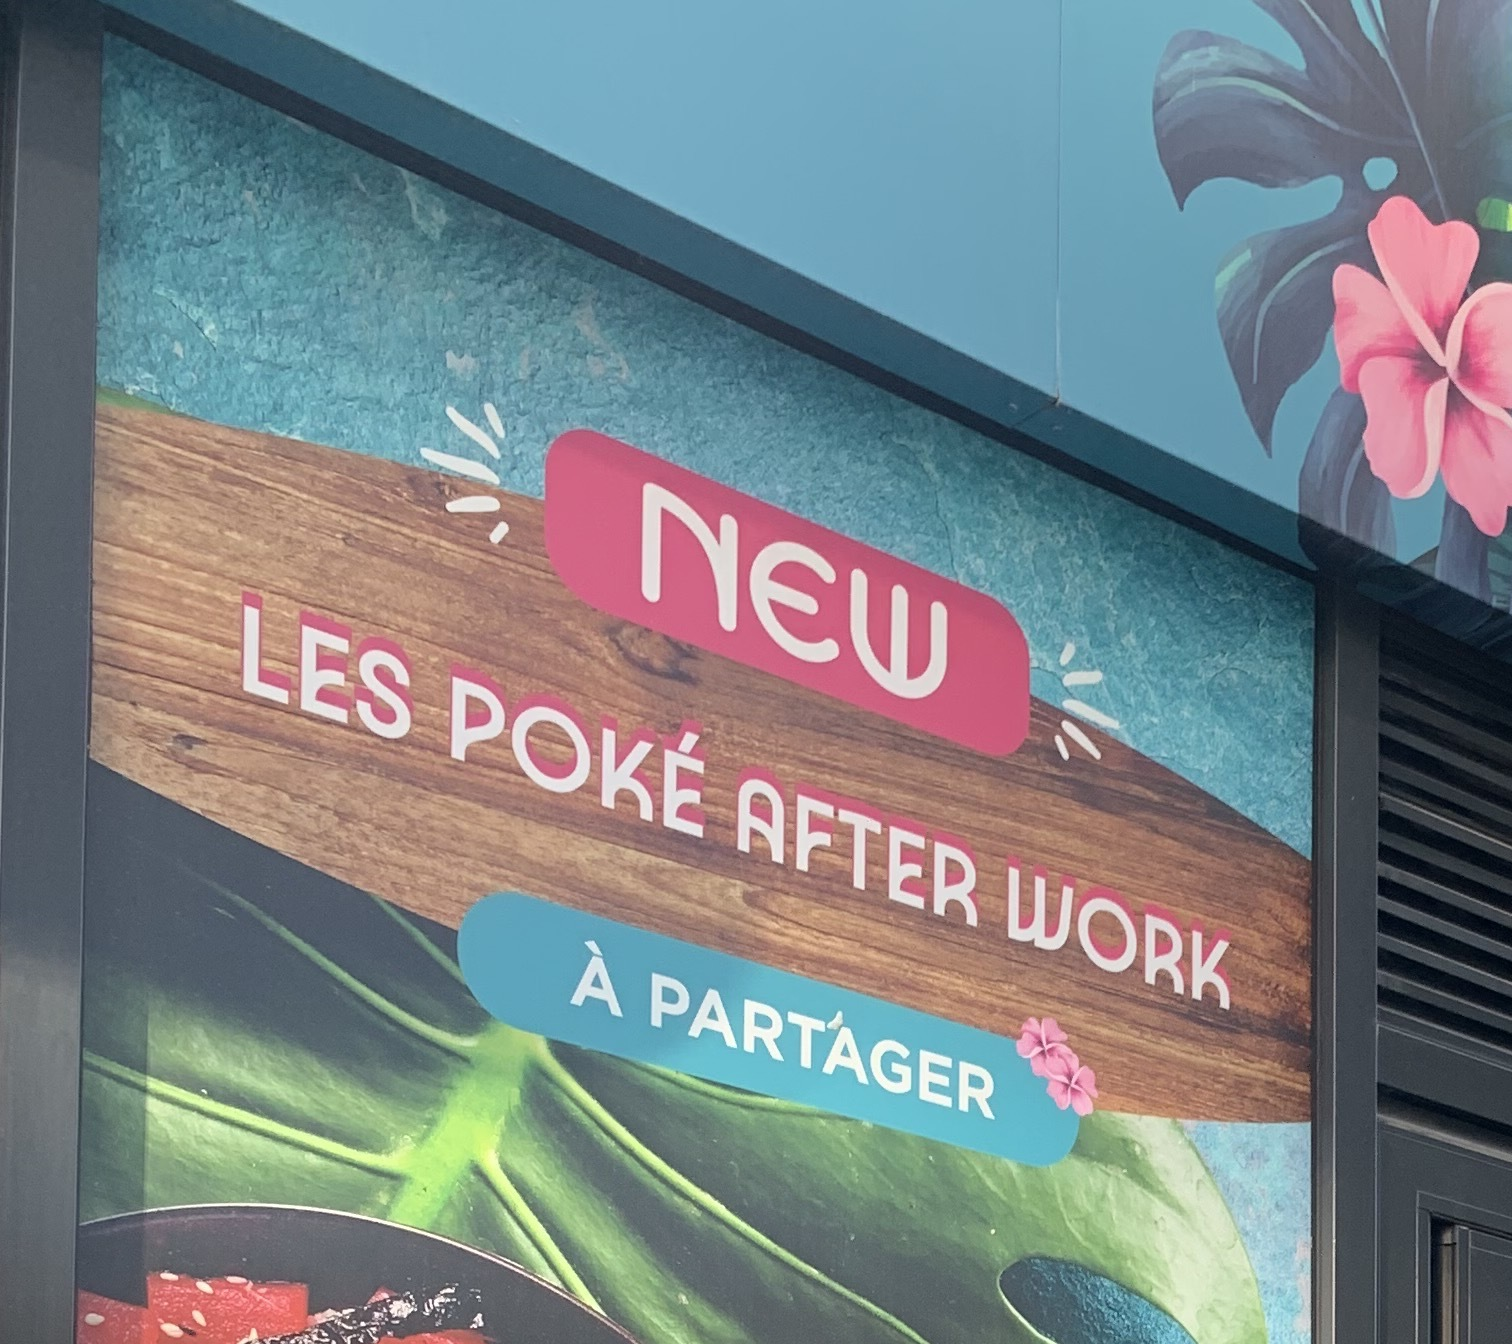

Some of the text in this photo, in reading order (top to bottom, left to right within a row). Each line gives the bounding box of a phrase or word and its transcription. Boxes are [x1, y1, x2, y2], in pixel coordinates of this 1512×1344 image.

[641, 481, 947, 698] NEW
[240, 595, 1233, 1011] LES POKÉ AFTER WORK
[569, 940, 623, 1018] À
